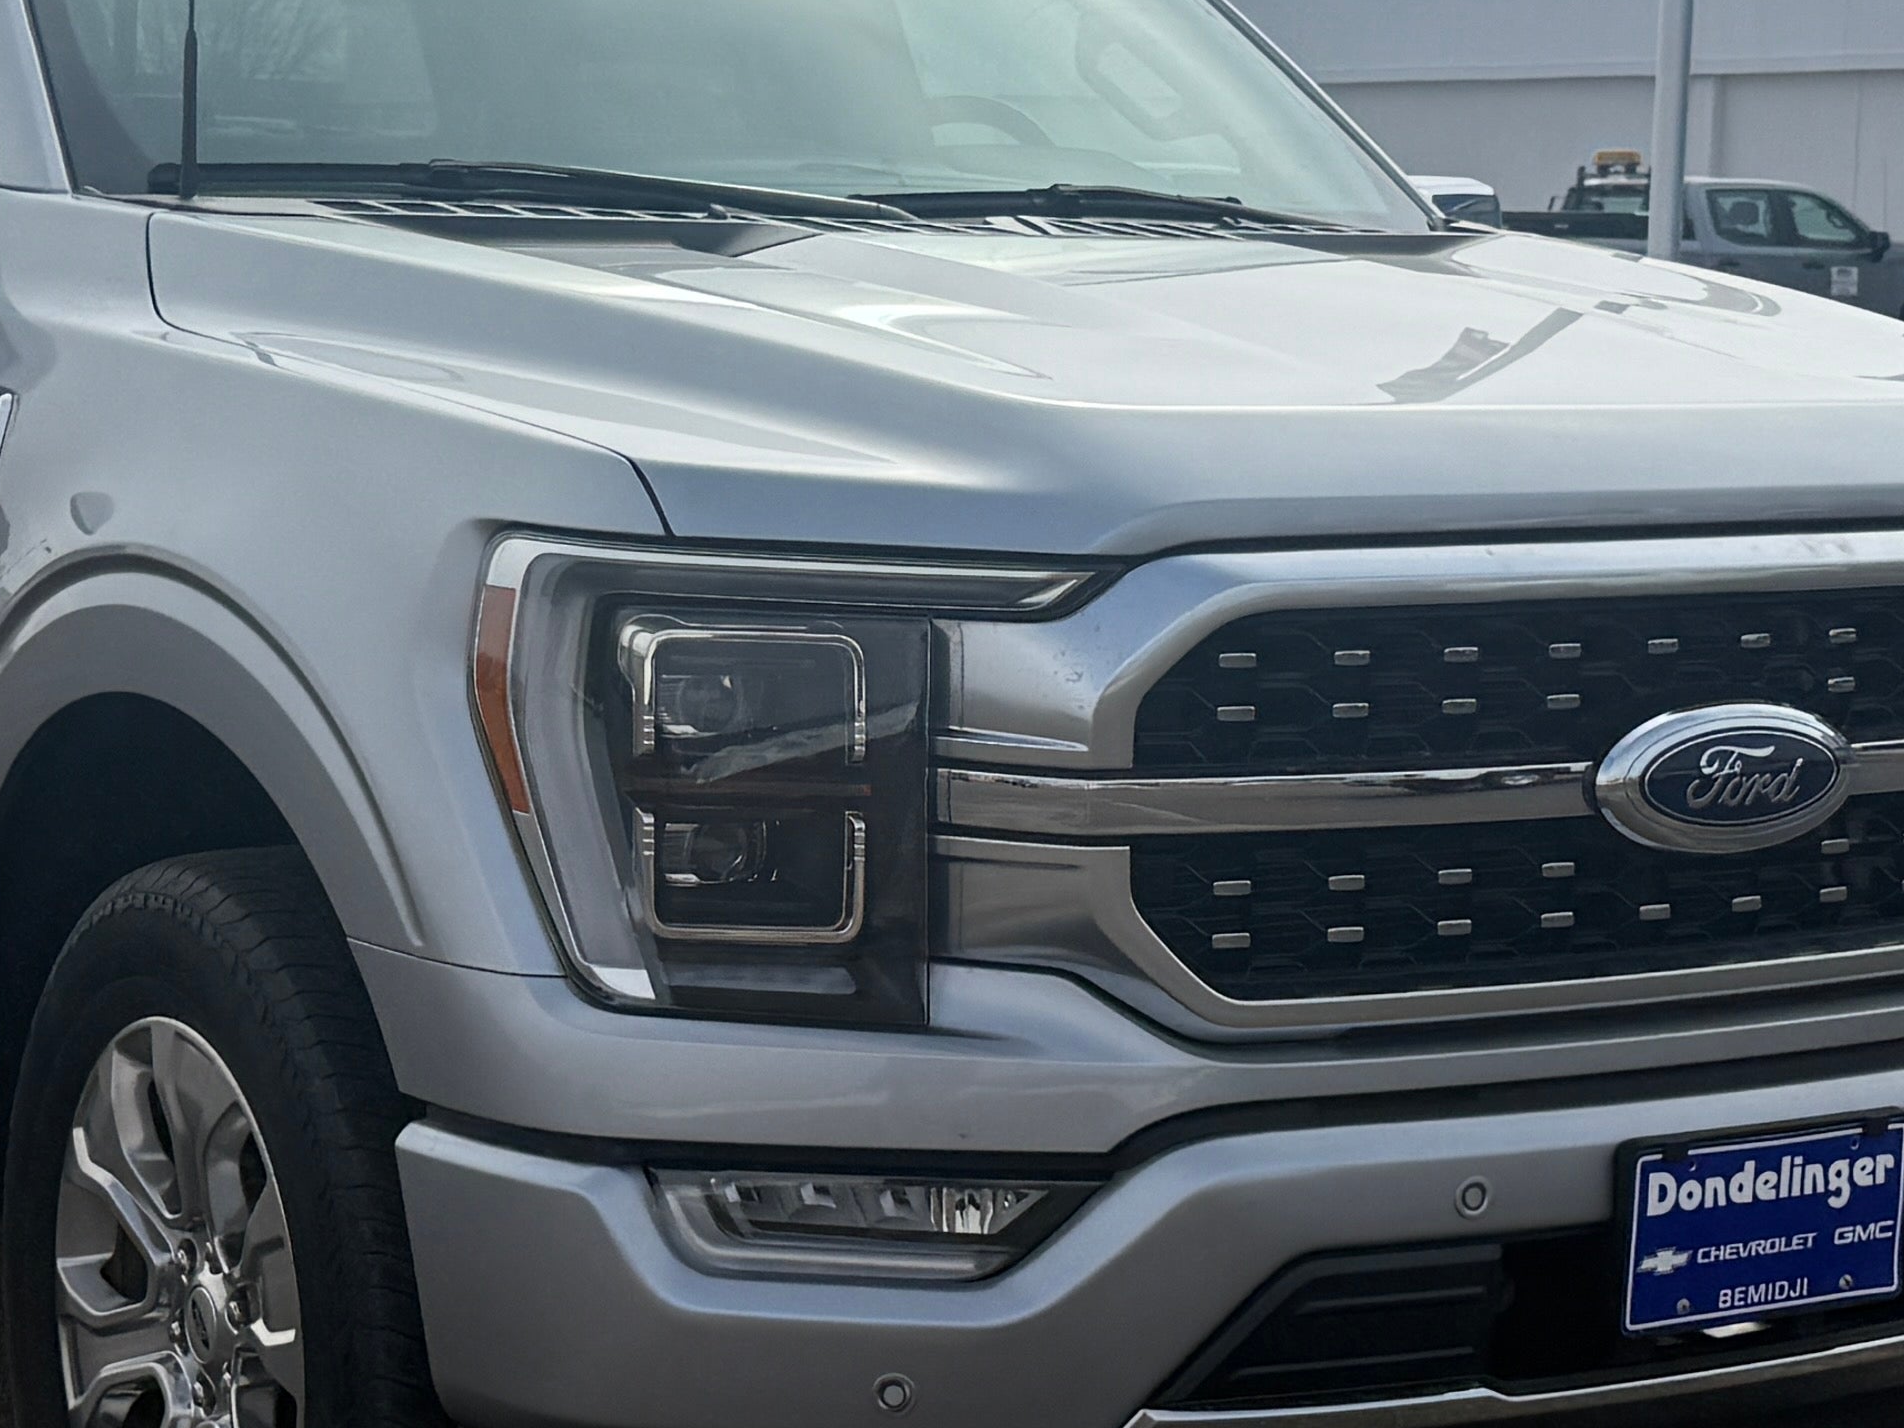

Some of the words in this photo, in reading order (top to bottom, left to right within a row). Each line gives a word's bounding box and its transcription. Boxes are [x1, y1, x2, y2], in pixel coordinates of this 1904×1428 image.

[1686, 745, 1804, 809] Ford
[1647, 1153, 1895, 1216] Dondelinger
[1697, 1232, 1818, 1263] CHEVROLET
[1833, 1220, 1895, 1245] GMC
[1718, 1277, 1808, 1309] BEMIDJI
